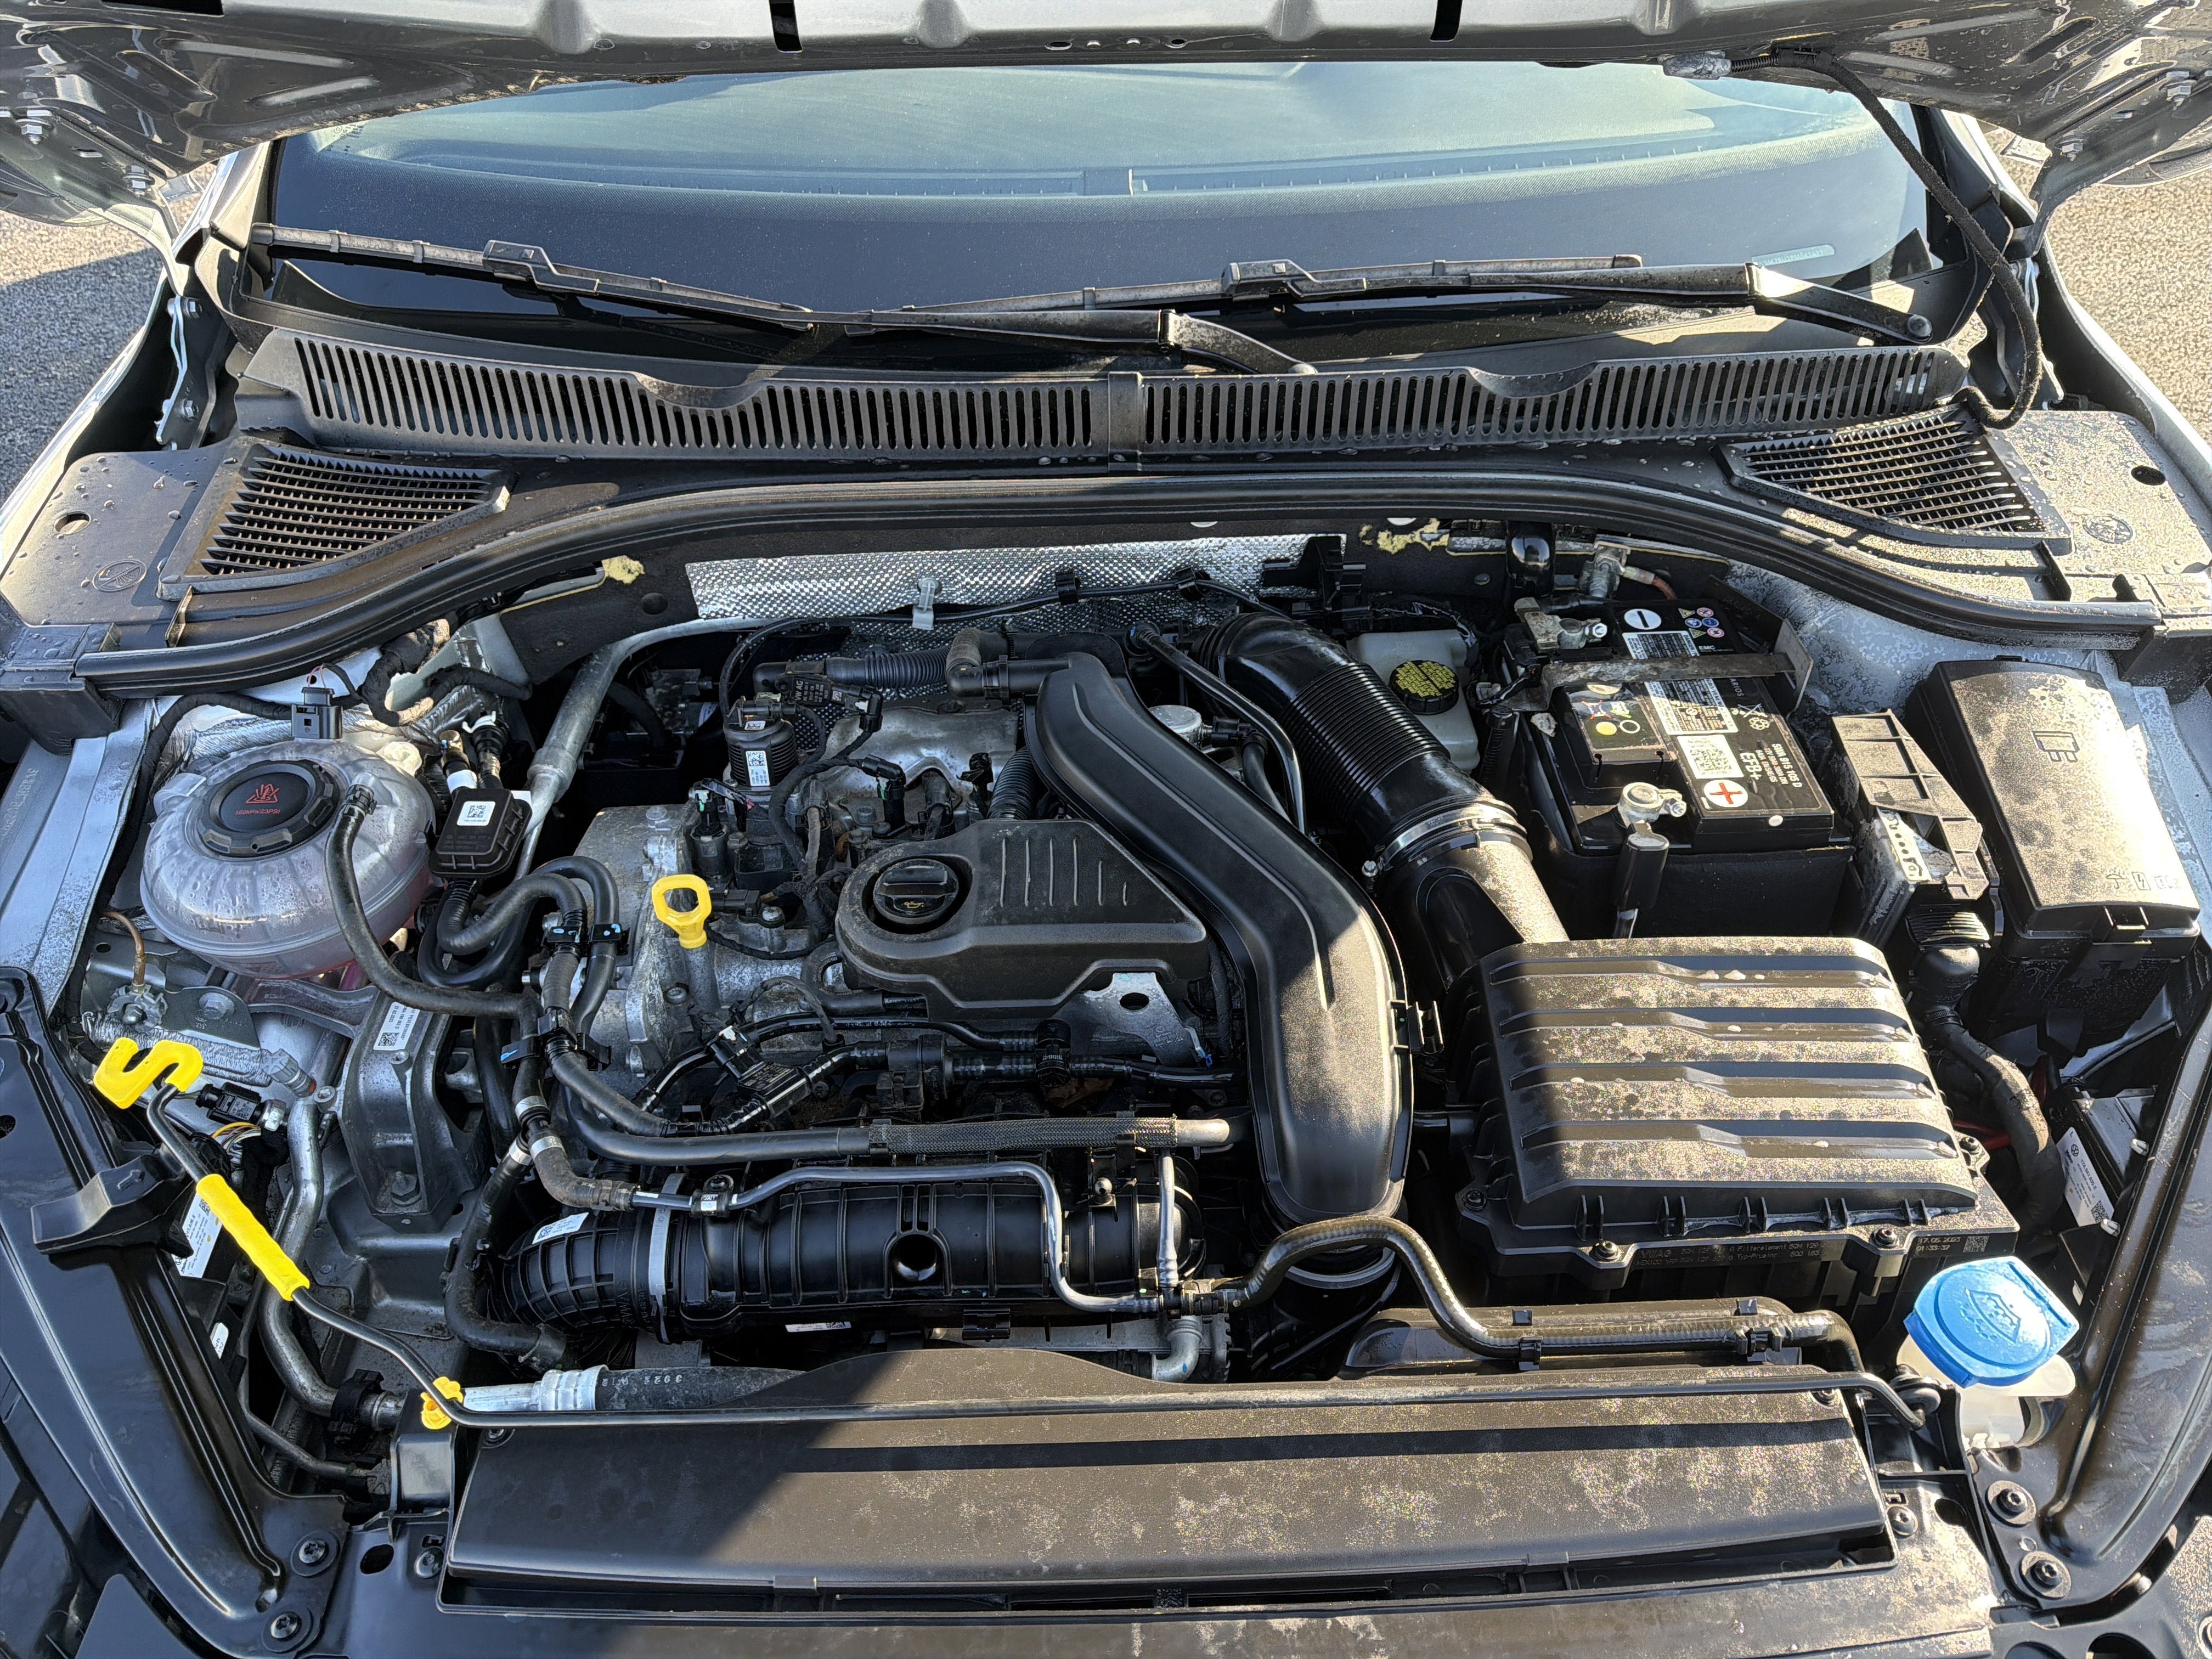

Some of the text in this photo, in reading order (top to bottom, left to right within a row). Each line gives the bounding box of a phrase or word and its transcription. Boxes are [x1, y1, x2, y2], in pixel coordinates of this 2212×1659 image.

[1740, 753, 1763, 780] EFB+
[1779, 758, 1793, 769] 915
[1786, 770, 1799, 781] 105
